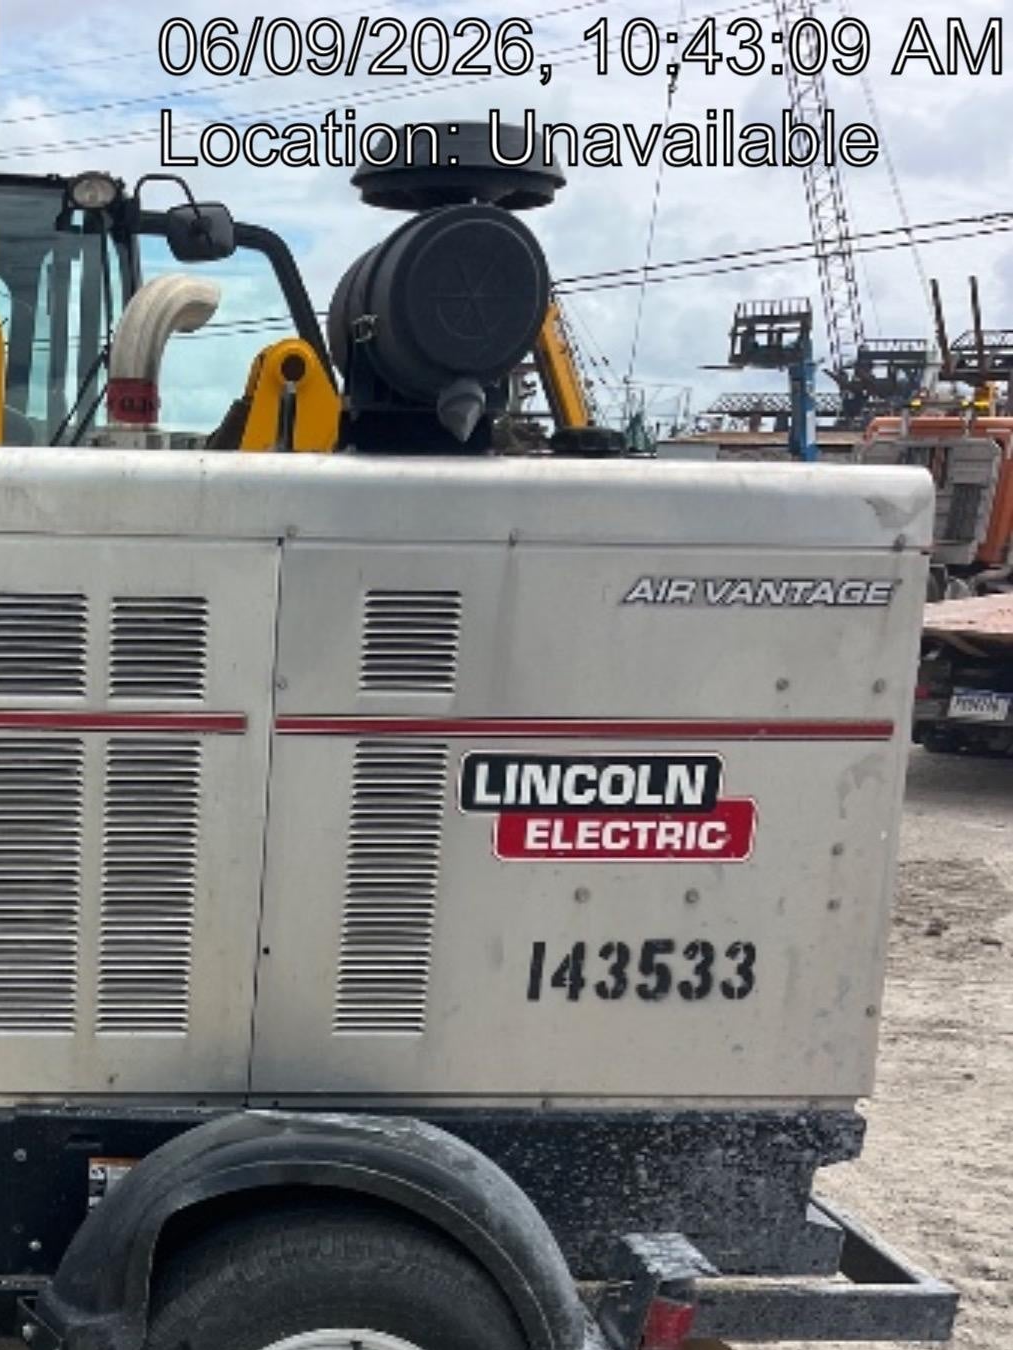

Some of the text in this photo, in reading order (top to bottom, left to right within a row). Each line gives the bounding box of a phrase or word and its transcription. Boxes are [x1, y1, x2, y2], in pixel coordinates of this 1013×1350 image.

[624, 577, 893, 606] AIR VANTAGE
[473, 762, 708, 806] LINCOLN
[523, 818, 728, 851] ELECTRIC
[526, 938, 757, 1002] 143533
